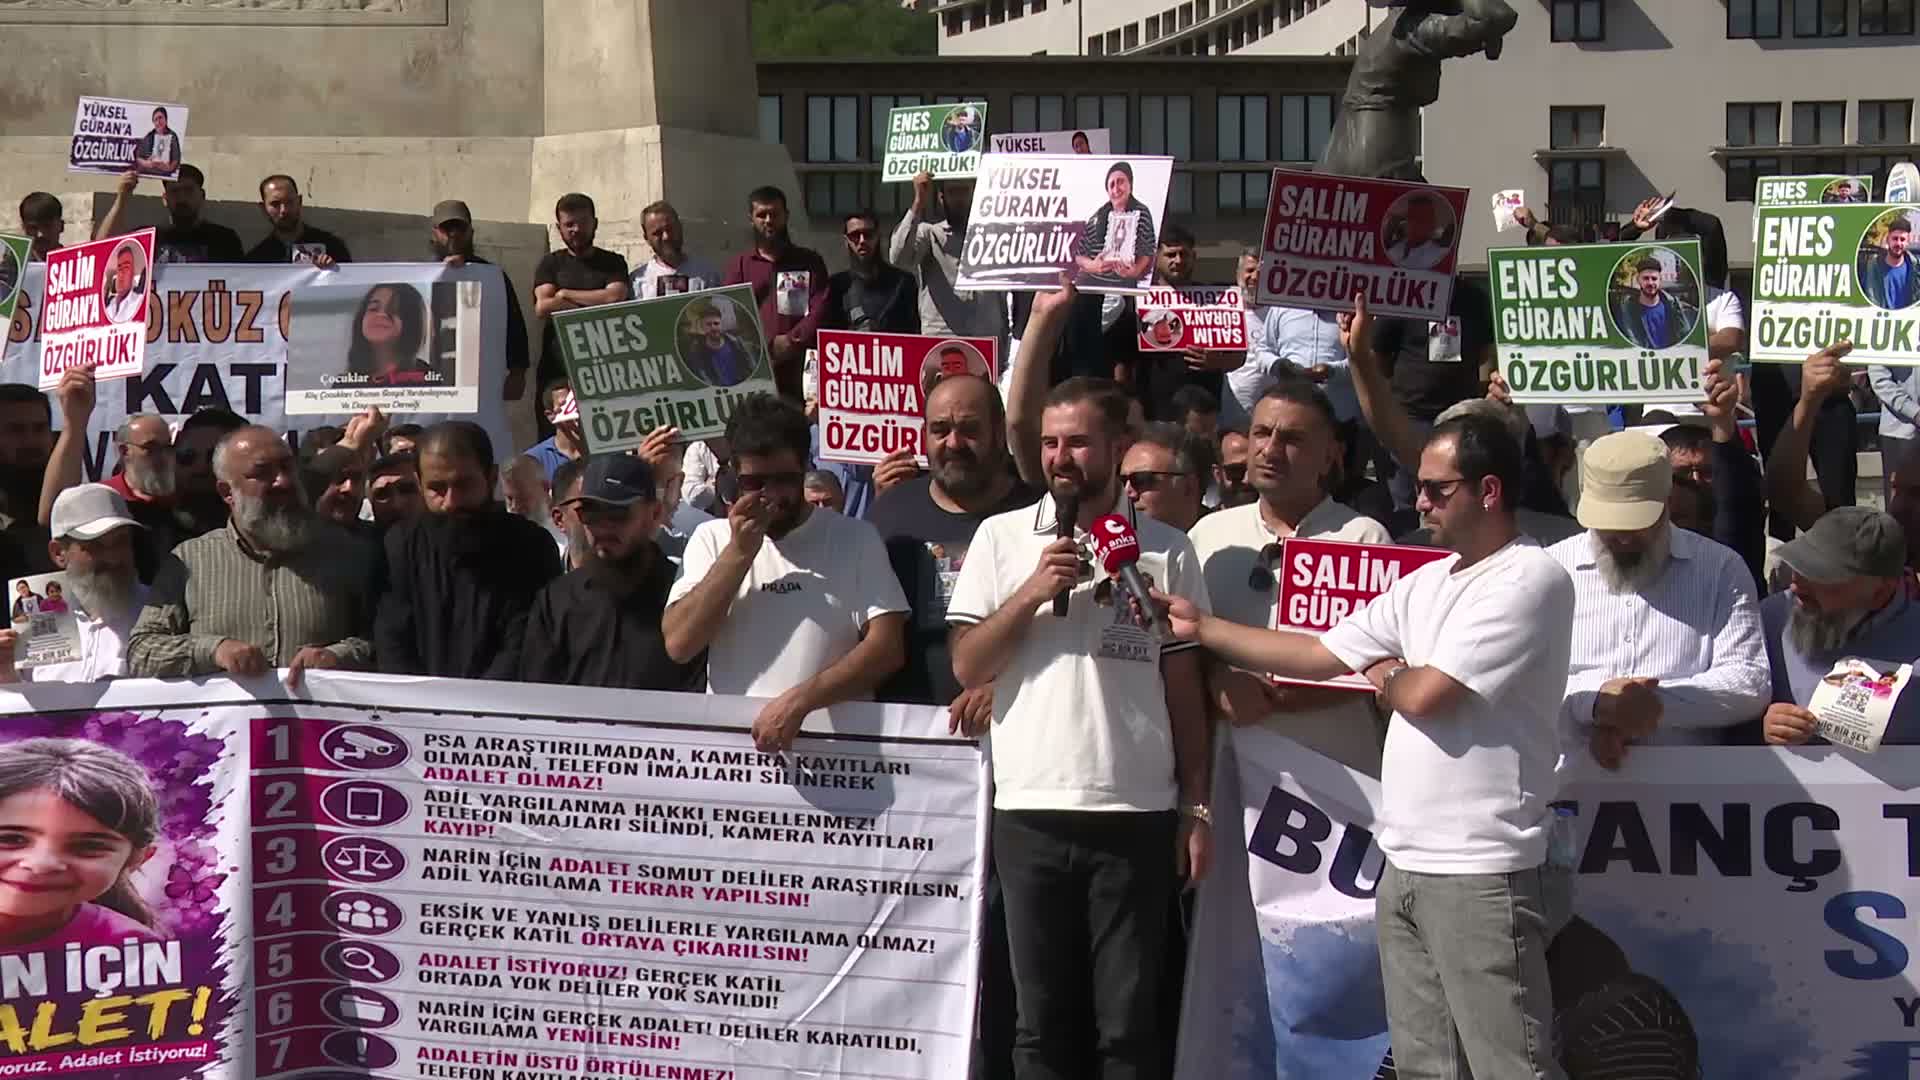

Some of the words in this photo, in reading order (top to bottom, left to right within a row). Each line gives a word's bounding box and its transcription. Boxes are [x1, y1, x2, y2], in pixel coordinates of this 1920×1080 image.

[83, 102, 128, 120] YÜKSEL
[892, 111, 931, 133] ENES
[74, 137, 137, 161] ÖZGÜRLÜK
[889, 131, 939, 151] GÜRAN'A
[996, 136, 1046, 152] YÜKSEL
[888, 154, 975, 175] ÖZGÜRLÜK!
[987, 162, 1061, 190] YÜKSEL
[979, 191, 1068, 218] GÜRAN'A
[1279, 183, 1369, 224] SALİM
[1762, 181, 1808, 200] ENES
[967, 226, 1077, 266] ÖZGÜRLÜK
[1273, 219, 1375, 261] GÜRAN'A
[1763, 215, 1835, 257] ENES
[49, 250, 96, 296] SALİM
[1498, 257, 1579, 300] ENES
[1759, 257, 1851, 297] GÜRAN'A
[46, 292, 99, 331] GÜRAN'A
[1502, 301, 1608, 340] GÜRAN'A
[566, 314, 648, 360] ENES
[1193, 328, 1242, 347] SALİM
[577, 354, 683, 396] GÜRAN'A
[825, 338, 903, 378] SALİM
[1507, 351, 1700, 392] ÖZGÜRLÜK!
[320, 373, 369, 387] Çocuklar
[825, 374, 918, 413] GÜRAN'A
[1108, 534, 1136, 548] anka
[761, 583, 802, 592] PRADA
[1292, 551, 1400, 592] SALİM
[266, 725, 289, 760] 1
[424, 734, 467, 749] PSA
[475, 737, 682, 763] ARAŞTIRILMADAN,
[691, 750, 787, 767] KAMERA
[797, 756, 911, 775] KAYITLARI
[424, 750, 538, 771] OLMADAN,
[547, 757, 638, 776] TELEFON
[647, 760, 752, 783] İMAJLARI
[760, 767, 875, 790] SİLİNEREK
[424, 767, 509, 785] ADALET
[517, 771, 604, 790] OLMAZ!
[264, 781, 297, 818] 2
[424, 789, 472, 805] ADİL
[479, 793, 626, 815] YARGILANMA
[635, 804, 704, 821] HAKKI
[713, 808, 875, 831] ENGELLENMEZ!
[424, 804, 513, 823] TELEFON
[521, 809, 620, 831] İMAJLARI
[629, 818, 714, 839] SİLİNDİ,
[722, 825, 815, 844] KAMERA
[823, 832, 934, 851] KAYITLARI
[424, 820, 496, 838] KAYIP!
[265, 836, 296, 874] 3
[423, 847, 490, 865] NARİN
[499, 850, 541, 870] İÇİN
[549, 857, 630, 876] ADALET
[637, 864, 715, 883] SOMUT
[722, 869, 804, 889] DELİLER
[812, 875, 965, 900] ARAŞTIRILSIN,
[421, 865, 473, 883] ADİL
[479, 870, 601, 892] YARGILAMA
[609, 879, 694, 899] TEKRAR
[702, 887, 811, 907] YAPILSIN!
[265, 892, 296, 928] 4
[420, 902, 483, 921] EKSİK
[492, 907, 518, 922] VE
[526, 909, 600, 930] YANLIŞ
[608, 916, 717, 938] DELİLERLE
[724, 925, 849, 947] YARGILAMA
[857, 935, 936, 953] OLMAZ!
[267, 942, 293, 978] 5
[420, 921, 505, 941] GERÇEK
[514, 926, 574, 945] KATİL
[581, 932, 665, 951] ORTAYA
[673, 939, 808, 962] ÇIKARILSIN!
[65, 937, 181, 998] İÇİN
[419, 953, 499, 971] ADALET
[507, 955, 628, 981] İSTİYORUZ!
[636, 967, 718, 988] GERÇEK
[725, 974, 785, 992] KATİL
[267, 992, 292, 1026] 6
[419, 970, 503, 988] ORTADA
[511, 975, 551, 991] YOK
[559, 980, 639, 999] DELİLER
[647, 986, 687, 1002] YOK
[694, 990, 778, 1009] SAYILDI!
[418, 1018, 538, 1040] YARGILAMA
[546, 1027, 680, 1050] YENİLENSİN!
[419, 1000, 484, 1018] NARİN
[492, 1003, 535, 1023] İÇİN
[543, 1010, 622, 1030] GERÇEK
[629, 1016, 712, 1036] ADALET!
[719, 1023, 799, 1043] DELİLER
[807, 1030, 922, 1054] KARATILDI,
[60, 1050, 123, 1070] Adalet
[129, 1043, 208, 1064] İstiyoruz!
[270, 1036, 291, 1070] 7
[417, 1046, 518, 1067] ADALETİN
[526, 1052, 578, 1071] ÜSTÜ
[417, 1062, 494, 1080] TELEFON
